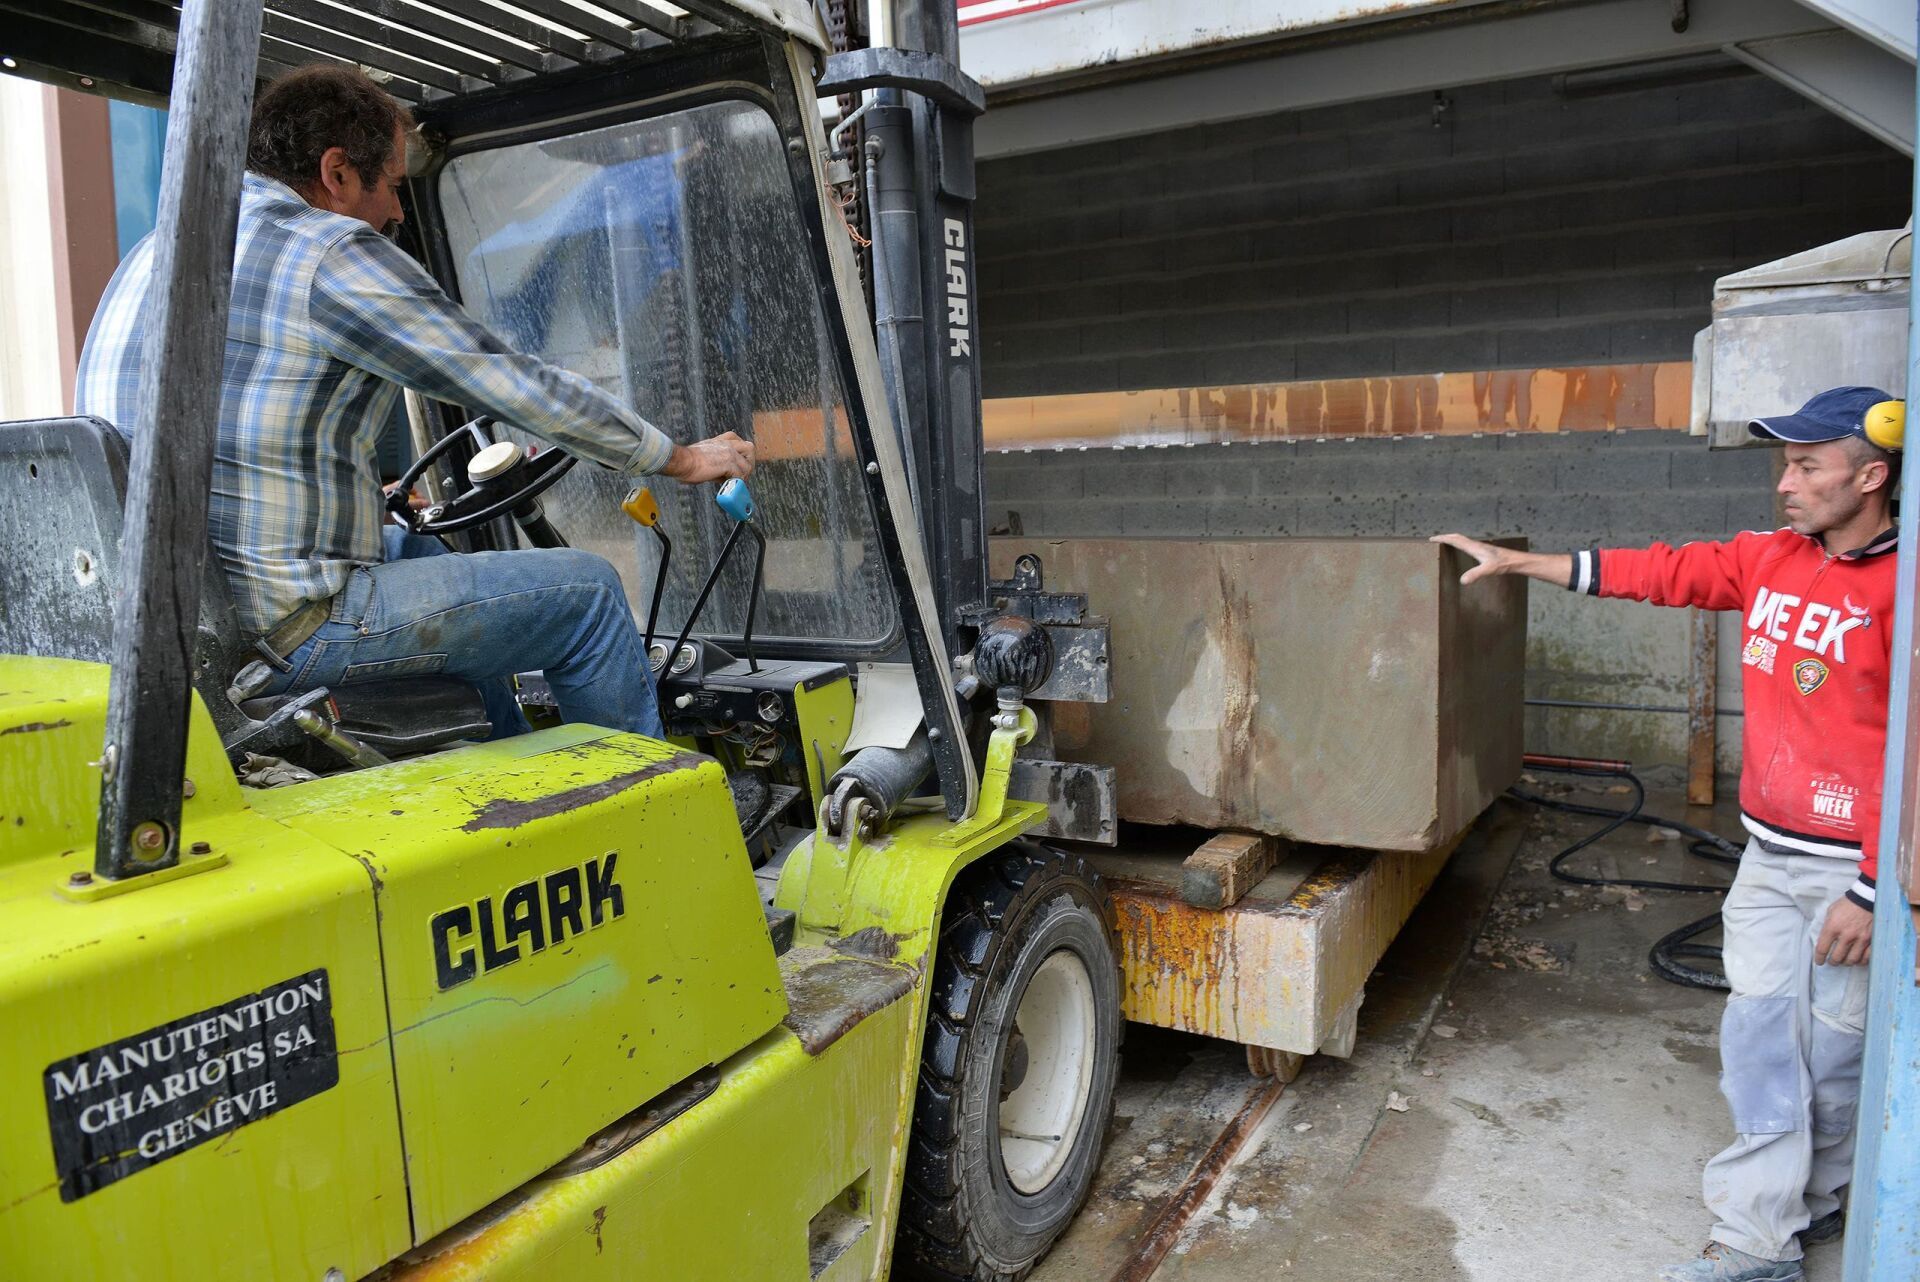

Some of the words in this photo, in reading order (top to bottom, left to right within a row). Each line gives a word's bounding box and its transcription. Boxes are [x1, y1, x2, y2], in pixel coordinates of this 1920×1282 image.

[944, 217, 970, 357] CLARK
[1813, 794, 1854, 819] WEEK
[429, 850, 626, 991] CLARK
[52, 978, 323, 1100] MANUTENTION
[79, 1041, 265, 1134] CHARIOTS
[273, 1024, 316, 1058] SA
[196, 1048, 209, 1062] &
[138, 1081, 278, 1159] GENÈVE
